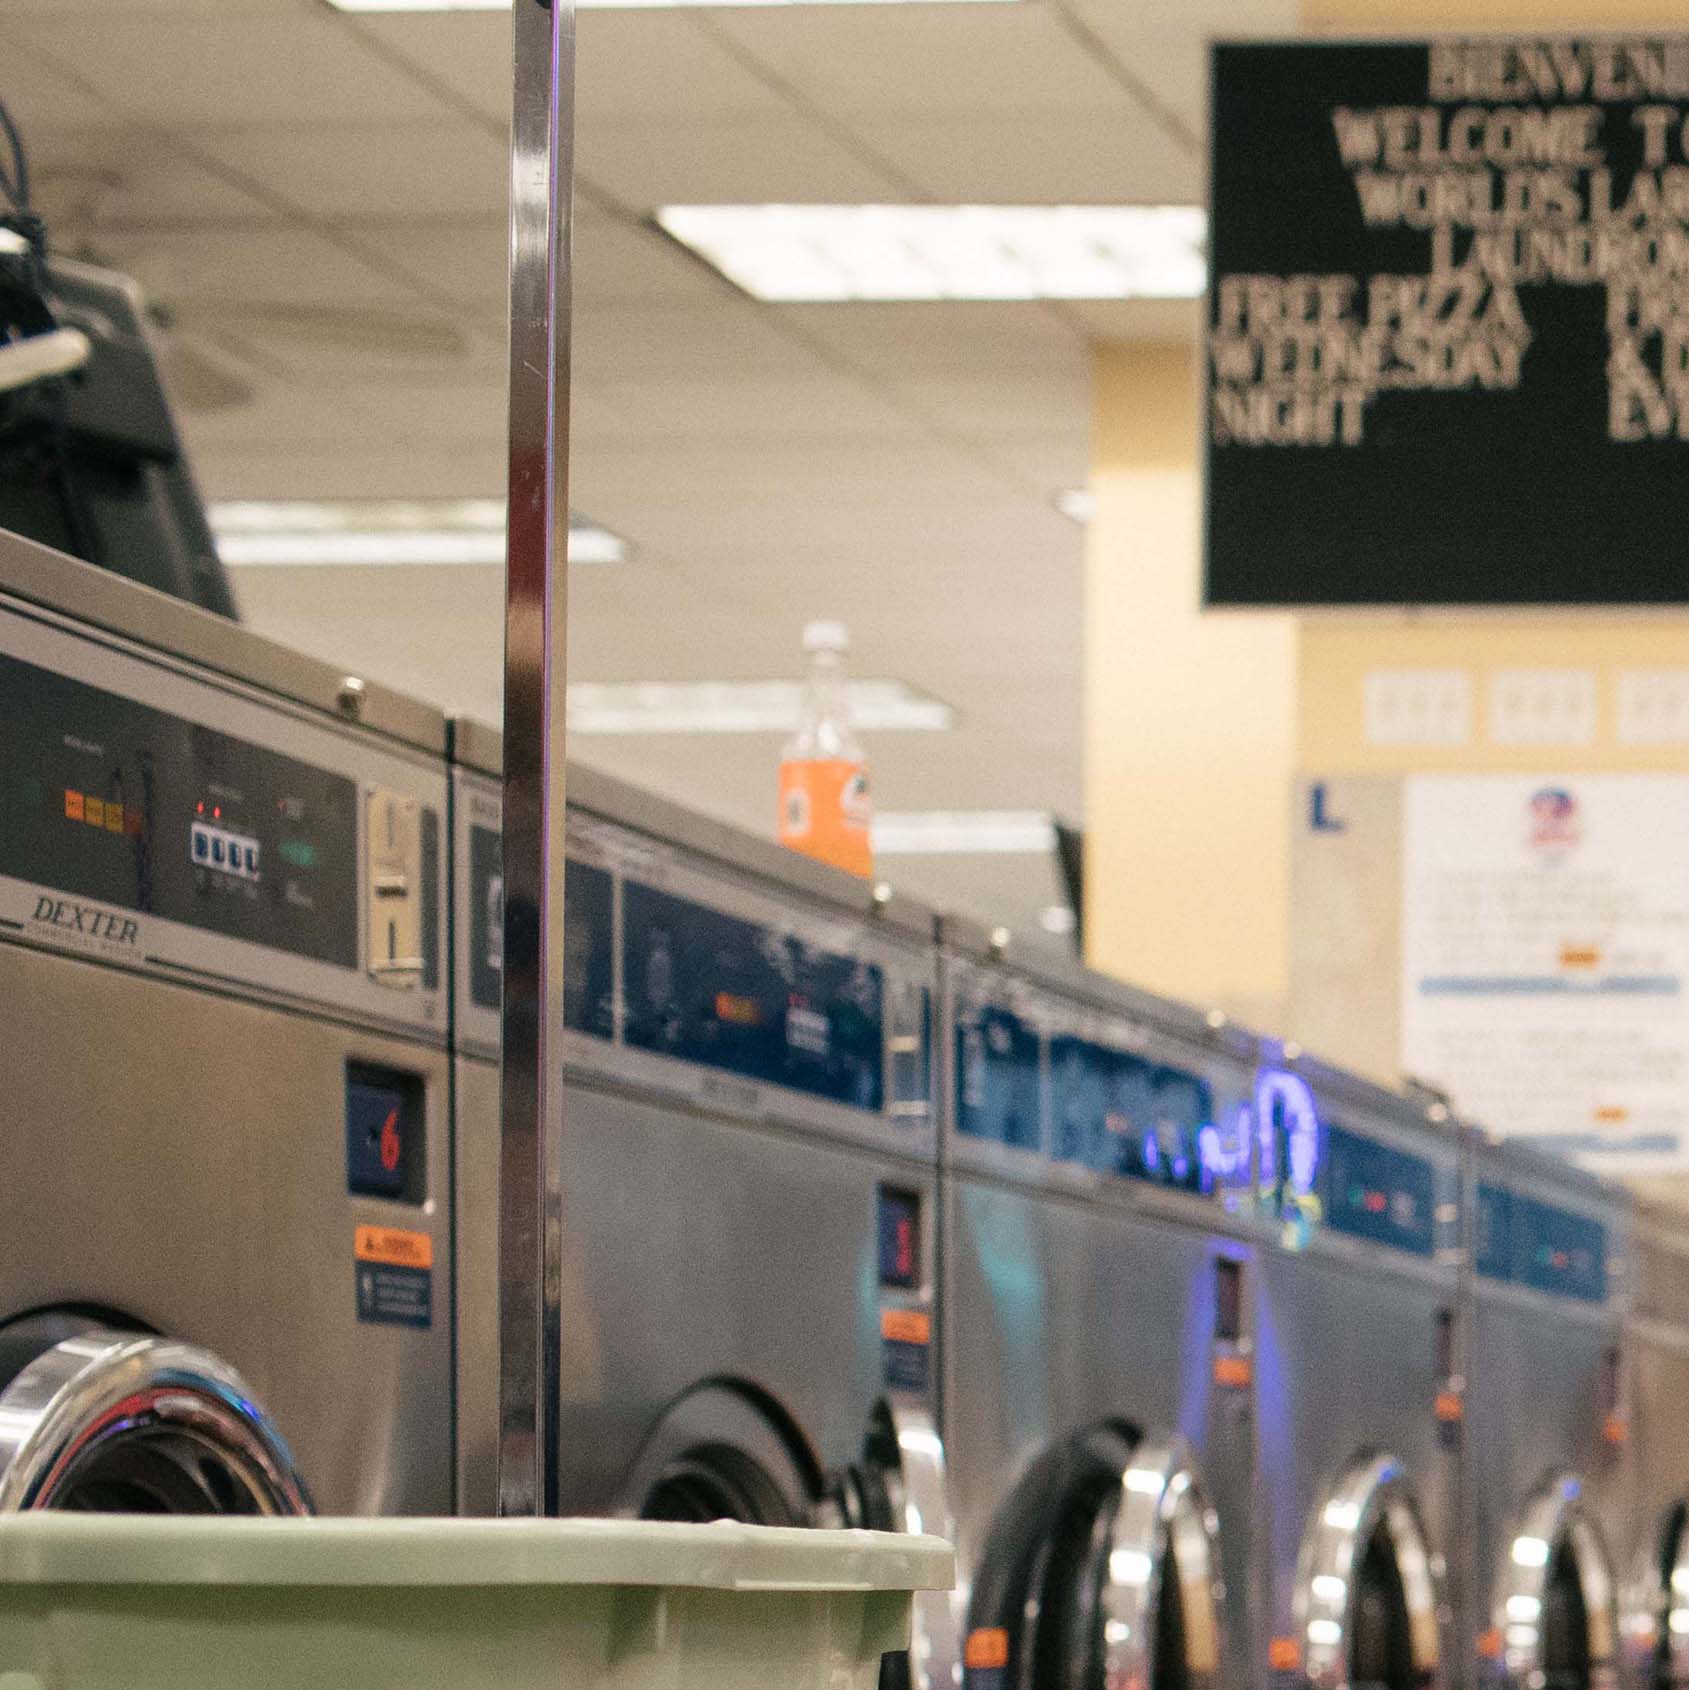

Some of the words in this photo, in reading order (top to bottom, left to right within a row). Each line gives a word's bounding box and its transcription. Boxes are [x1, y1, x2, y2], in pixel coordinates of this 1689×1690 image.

[1332, 103, 1603, 168] WELCOME
[1352, 166, 1583, 229] WORLDS
[1217, 272, 1358, 334] FREE
[1366, 272, 1532, 338] PIZZA
[1208, 332, 1526, 390] WEDNESDAY
[1208, 388, 1366, 446] NIGHT
[33, 895, 139, 944] DEXTER
